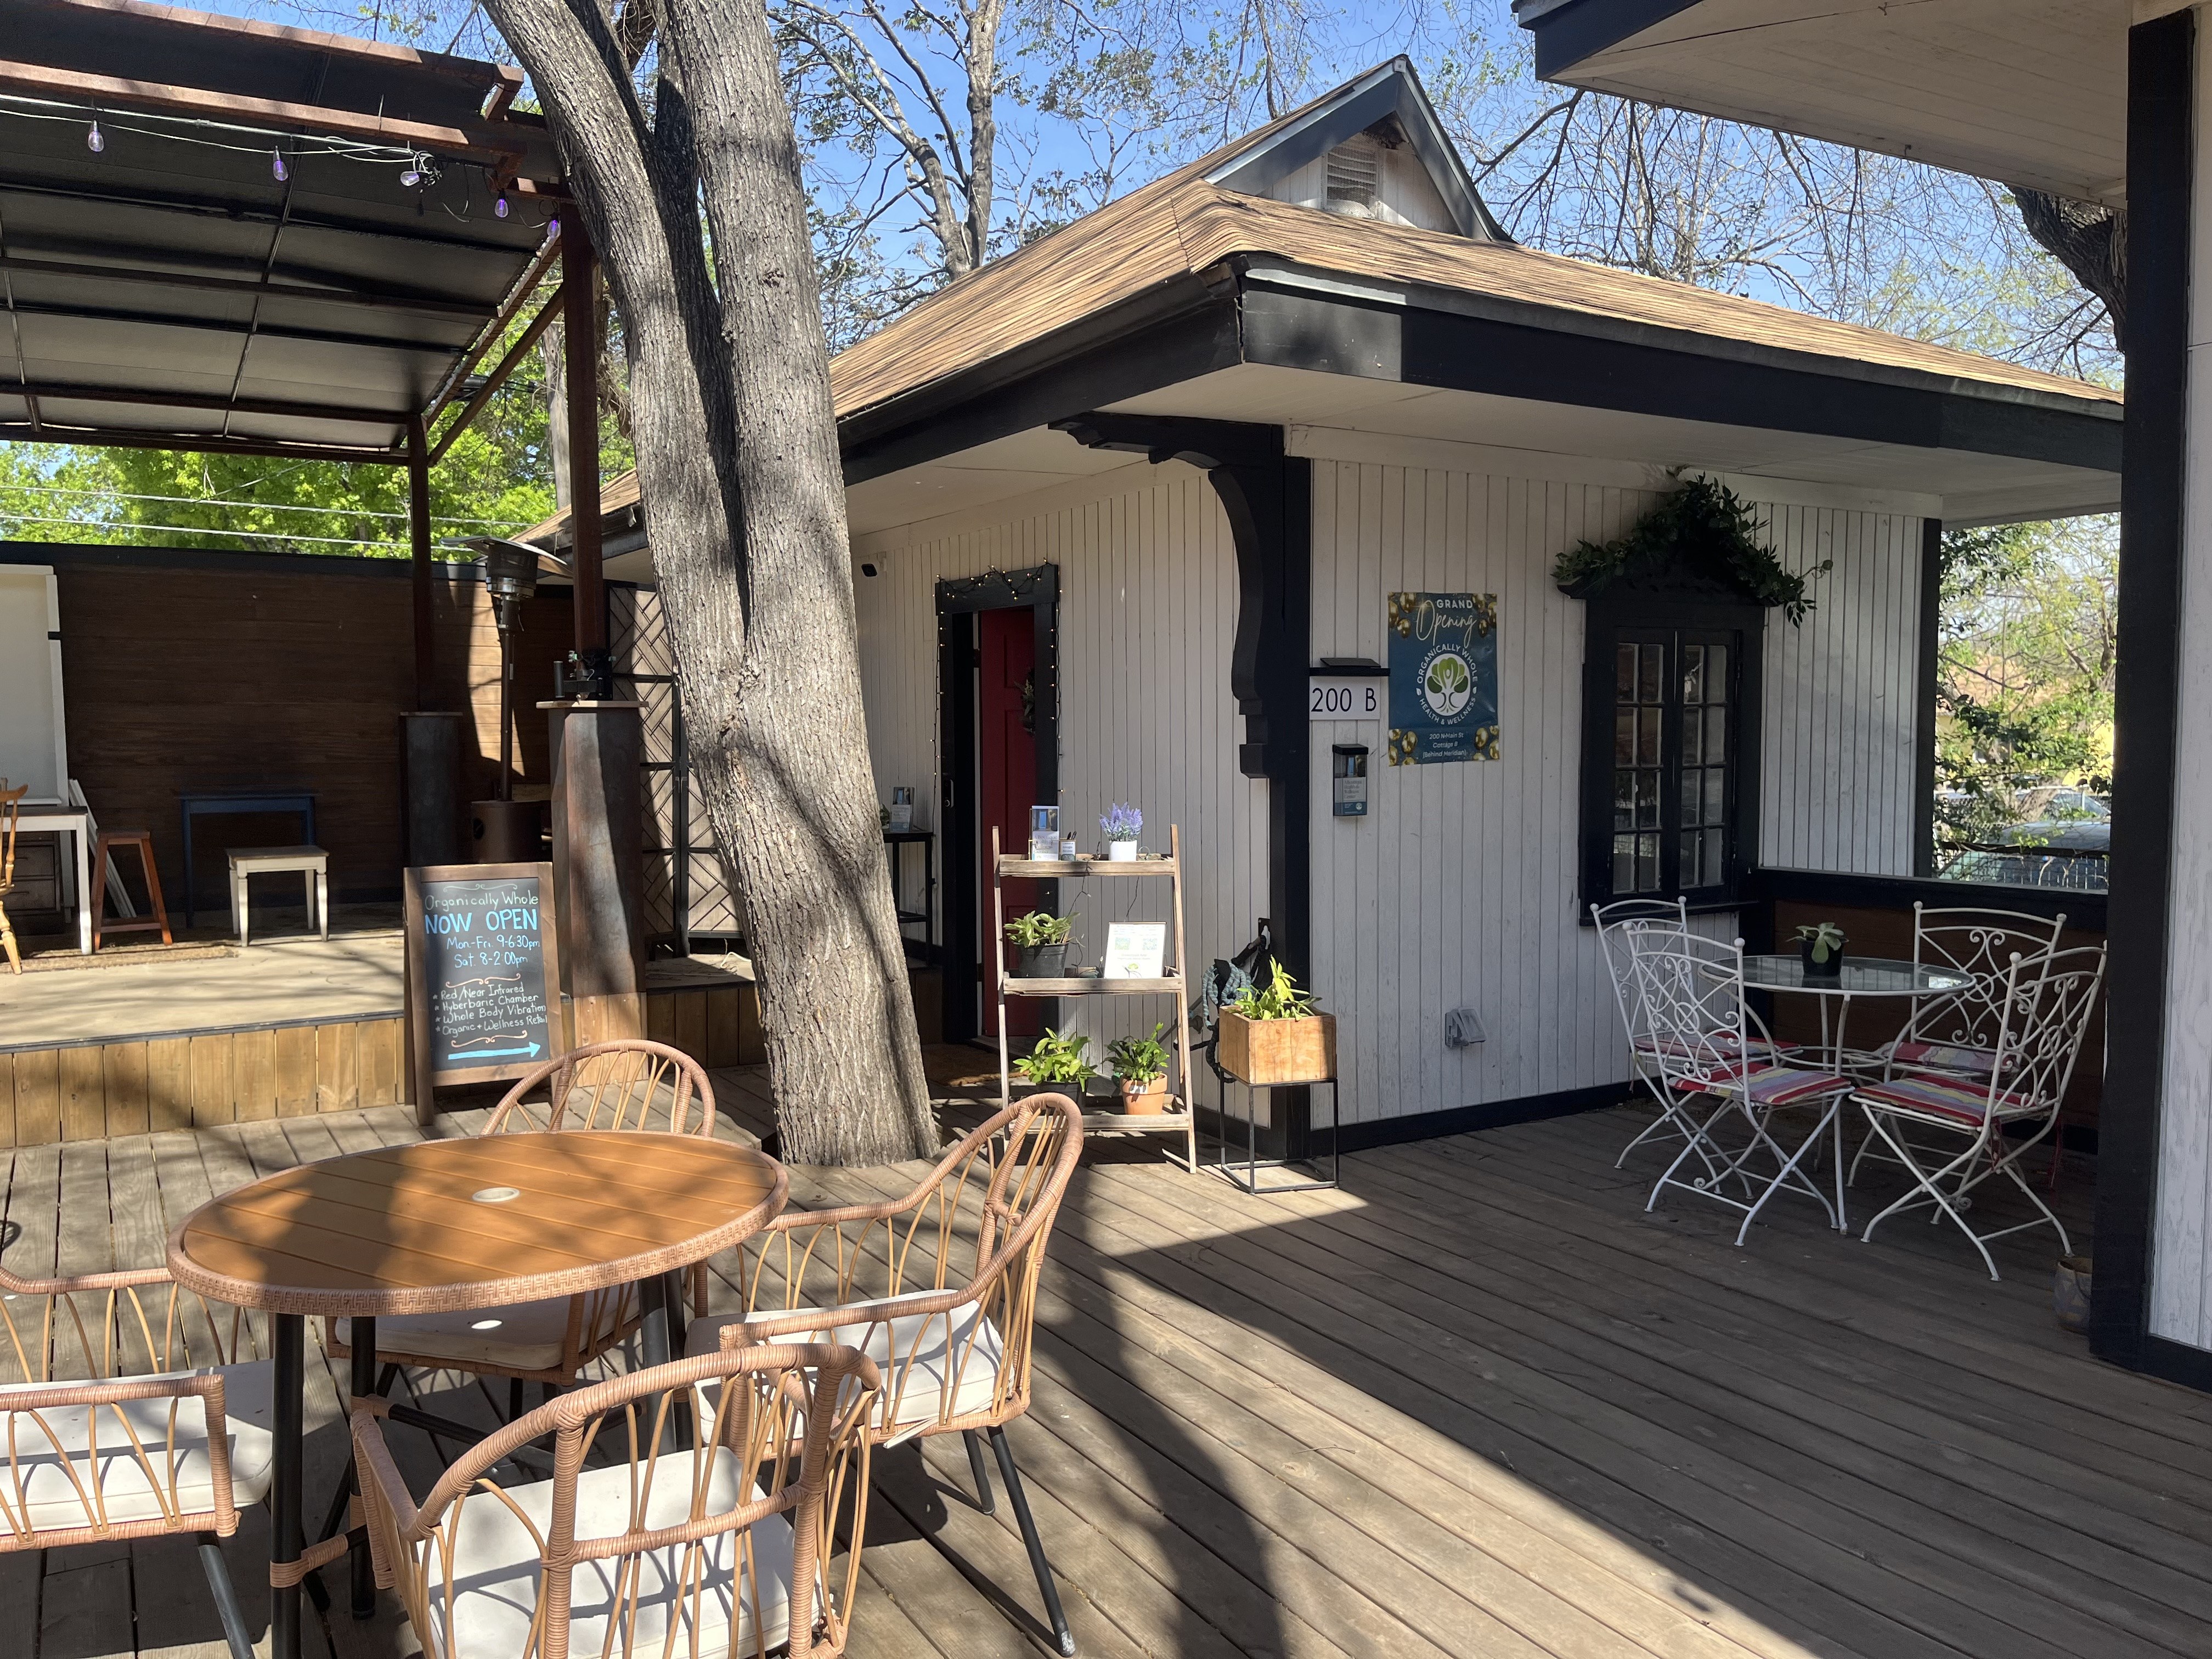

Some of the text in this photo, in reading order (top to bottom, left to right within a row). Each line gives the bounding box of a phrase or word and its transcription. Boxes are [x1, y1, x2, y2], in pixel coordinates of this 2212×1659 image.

[1436, 599, 1473, 608] GRAND
[1416, 600, 1477, 648] Opening
[1417, 644, 1478, 684] ORGANICALLY WHOLE
[1311, 687, 1376, 712] 200 B
[1419, 698, 1440, 723] HEALTH
[1447, 697, 1476, 725] WELLNESS
[425, 889, 539, 912] Organically Whole
[425, 909, 538, 935] NOW OPEN
[487, 981, 524, 996] Infrared
[442, 993, 539, 1014] Hyberbaric Chamber
[443, 1002, 546, 1024] Whole Body Vibration
[442, 1022, 476, 1038] Organic
[484, 1019, 524, 1031] Wellness
[526, 1013, 548, 1025] Retail
